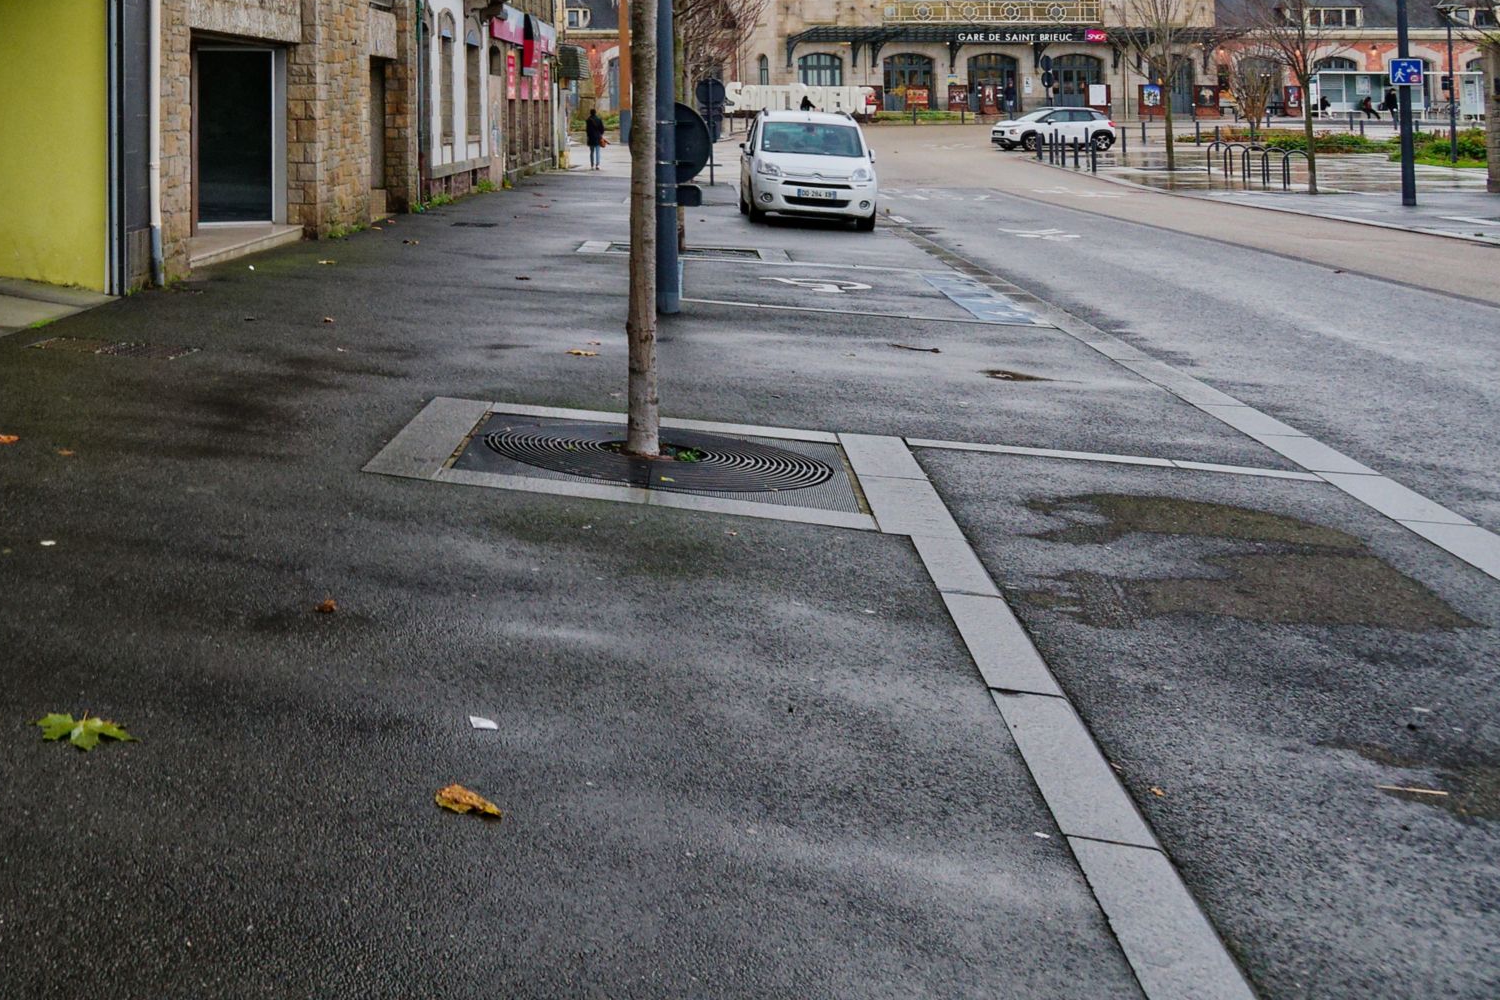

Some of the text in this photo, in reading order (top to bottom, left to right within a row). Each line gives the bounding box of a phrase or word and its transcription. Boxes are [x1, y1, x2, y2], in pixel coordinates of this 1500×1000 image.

[957, 33, 1073, 41] GARE DE SAINT BRIEUC
